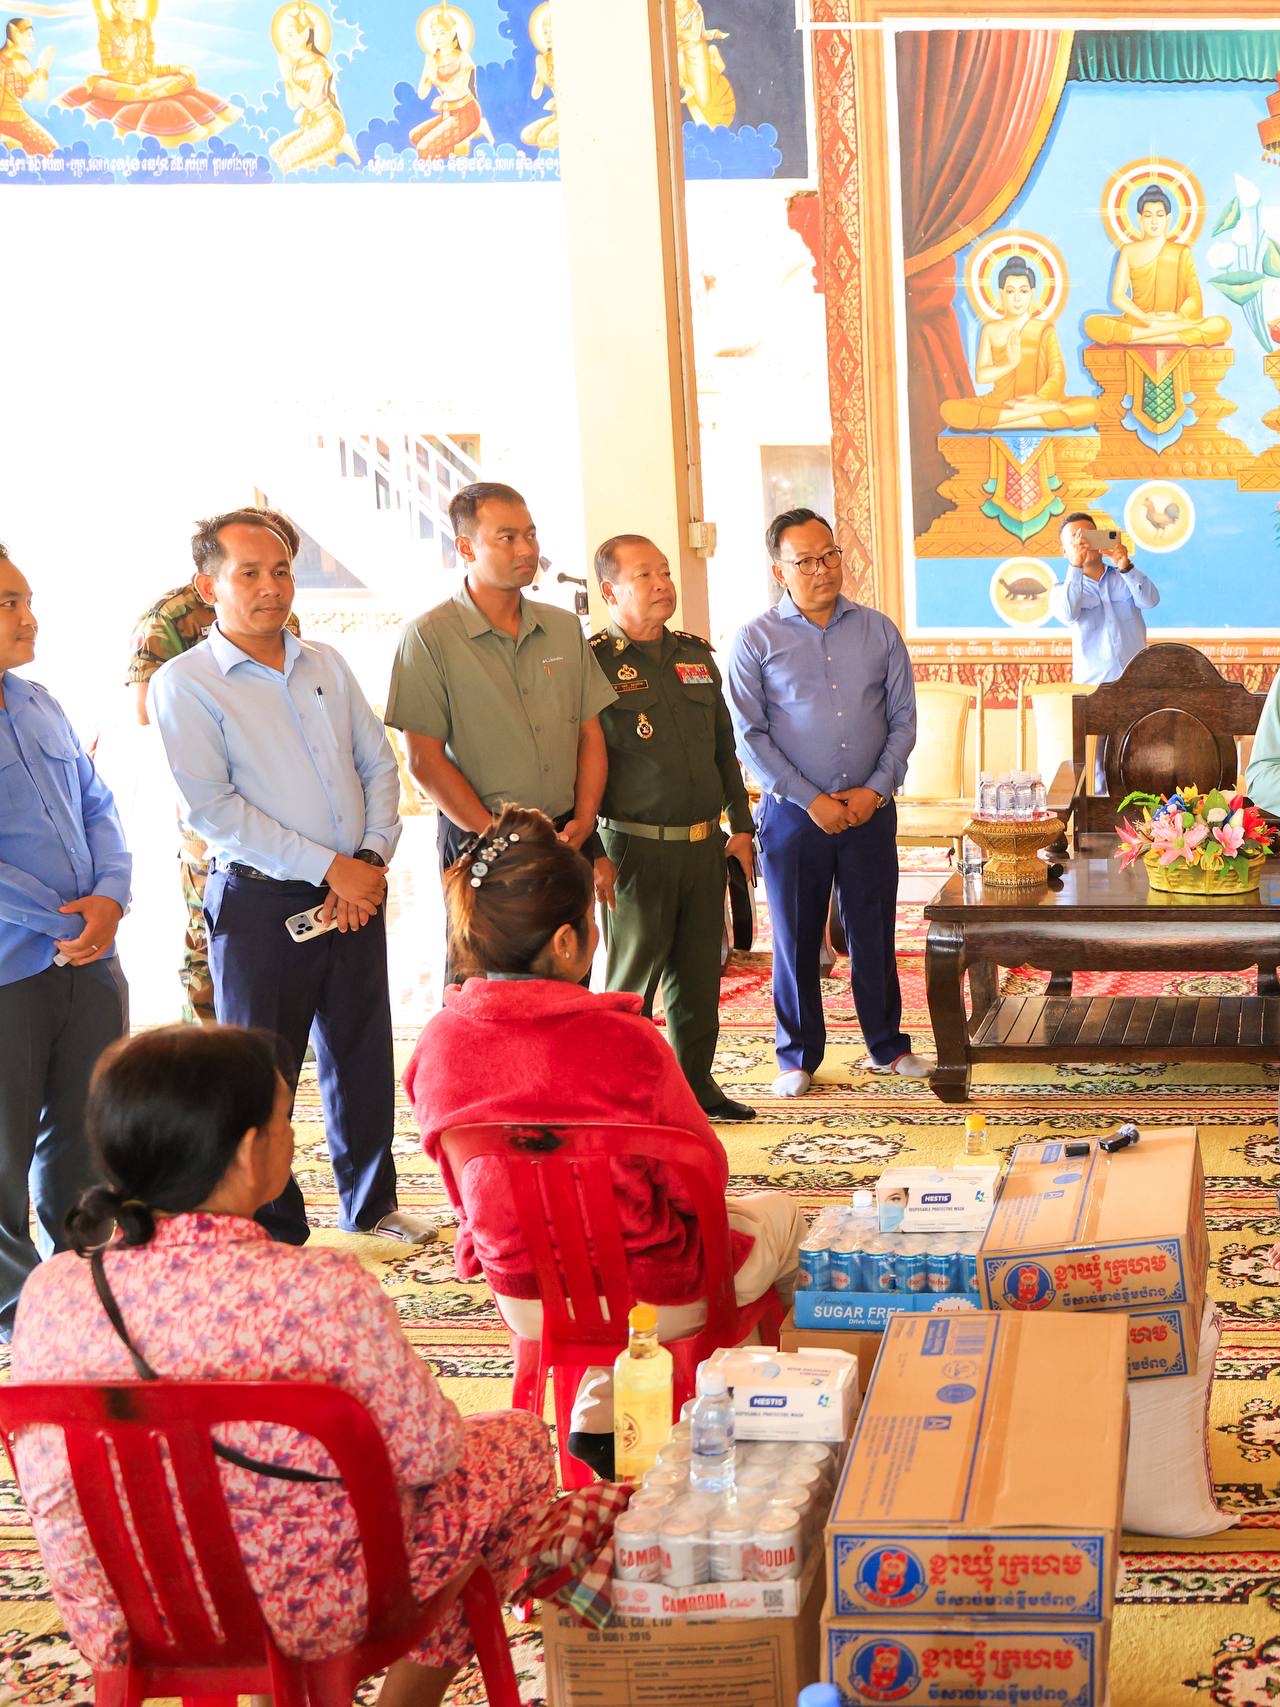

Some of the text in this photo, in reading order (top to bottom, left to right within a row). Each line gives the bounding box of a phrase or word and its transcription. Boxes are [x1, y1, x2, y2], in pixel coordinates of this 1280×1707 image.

[924, 1194, 949, 1203] HESTIS
[814, 1305, 864, 1320] SUGAR
[753, 1397, 784, 1406] HESTIS
